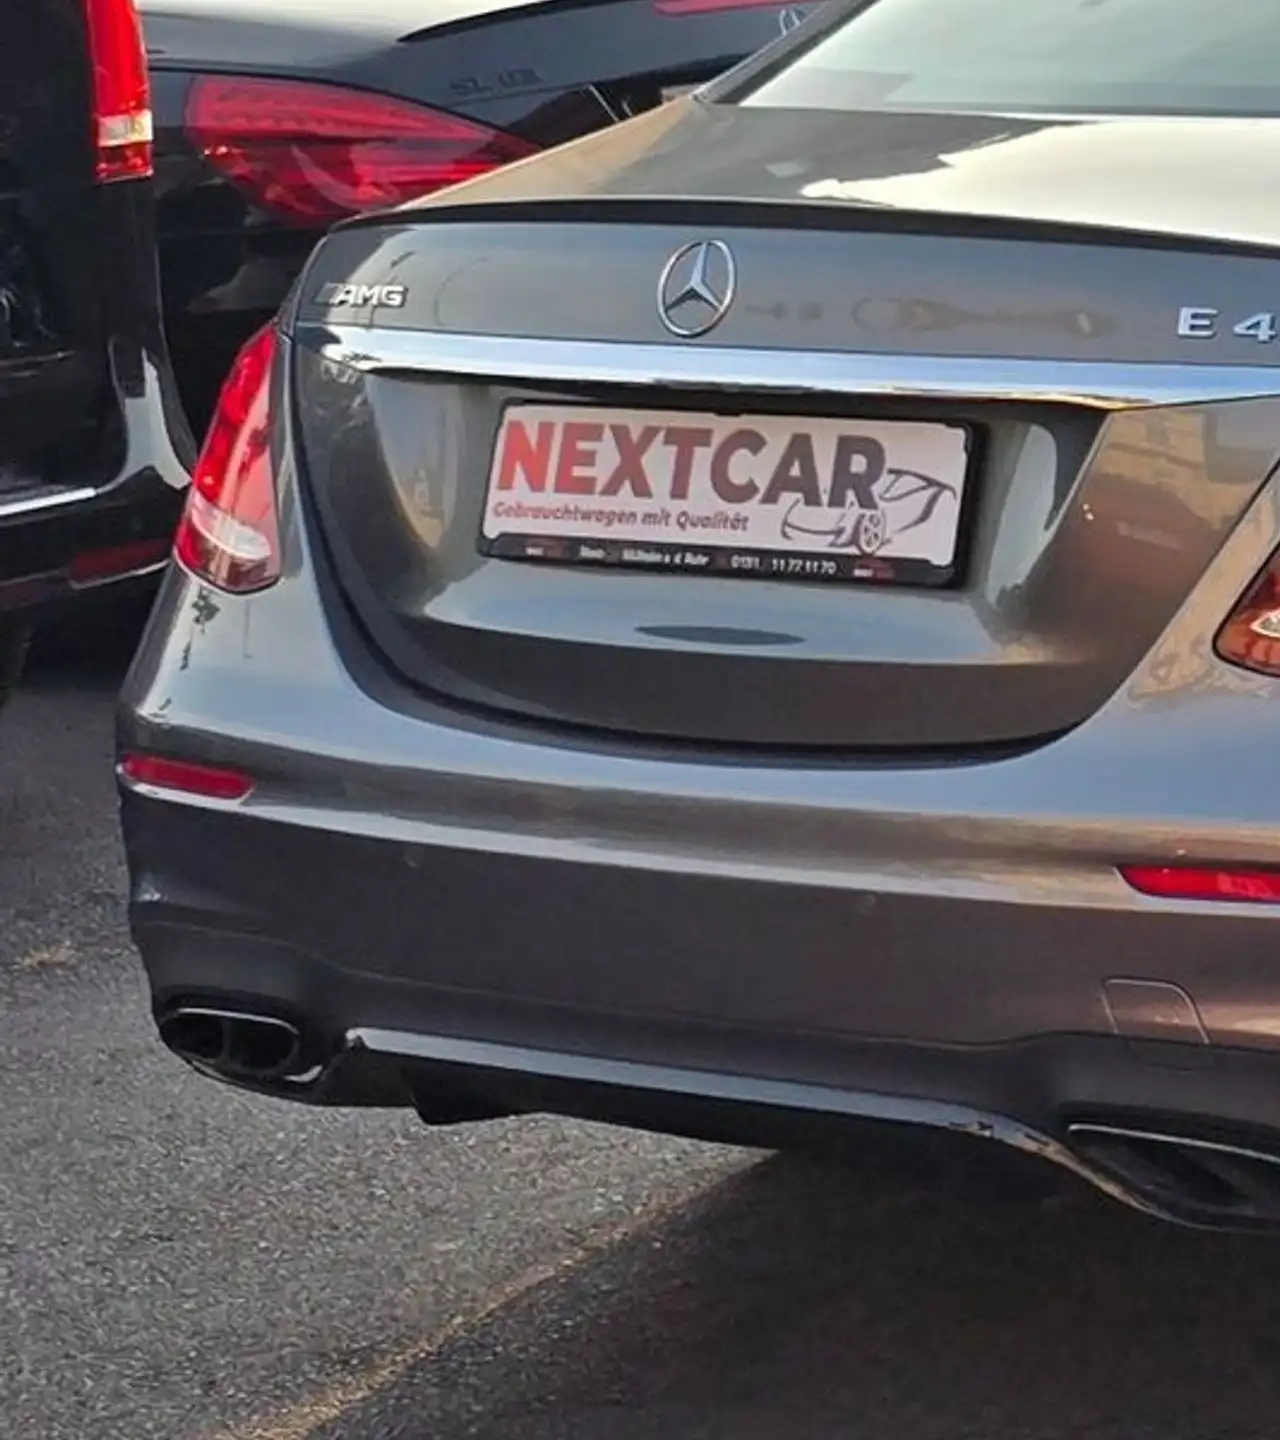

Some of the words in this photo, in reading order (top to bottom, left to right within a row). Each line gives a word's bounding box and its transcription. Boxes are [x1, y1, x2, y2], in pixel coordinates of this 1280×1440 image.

[328, 283, 409, 308] AMG
[1178, 306, 1219, 338] E
[496, 418, 888, 510] NEXTCAR
[493, 500, 637, 527] Gebrauchtwagen
[640, 508, 671, 527] mit
